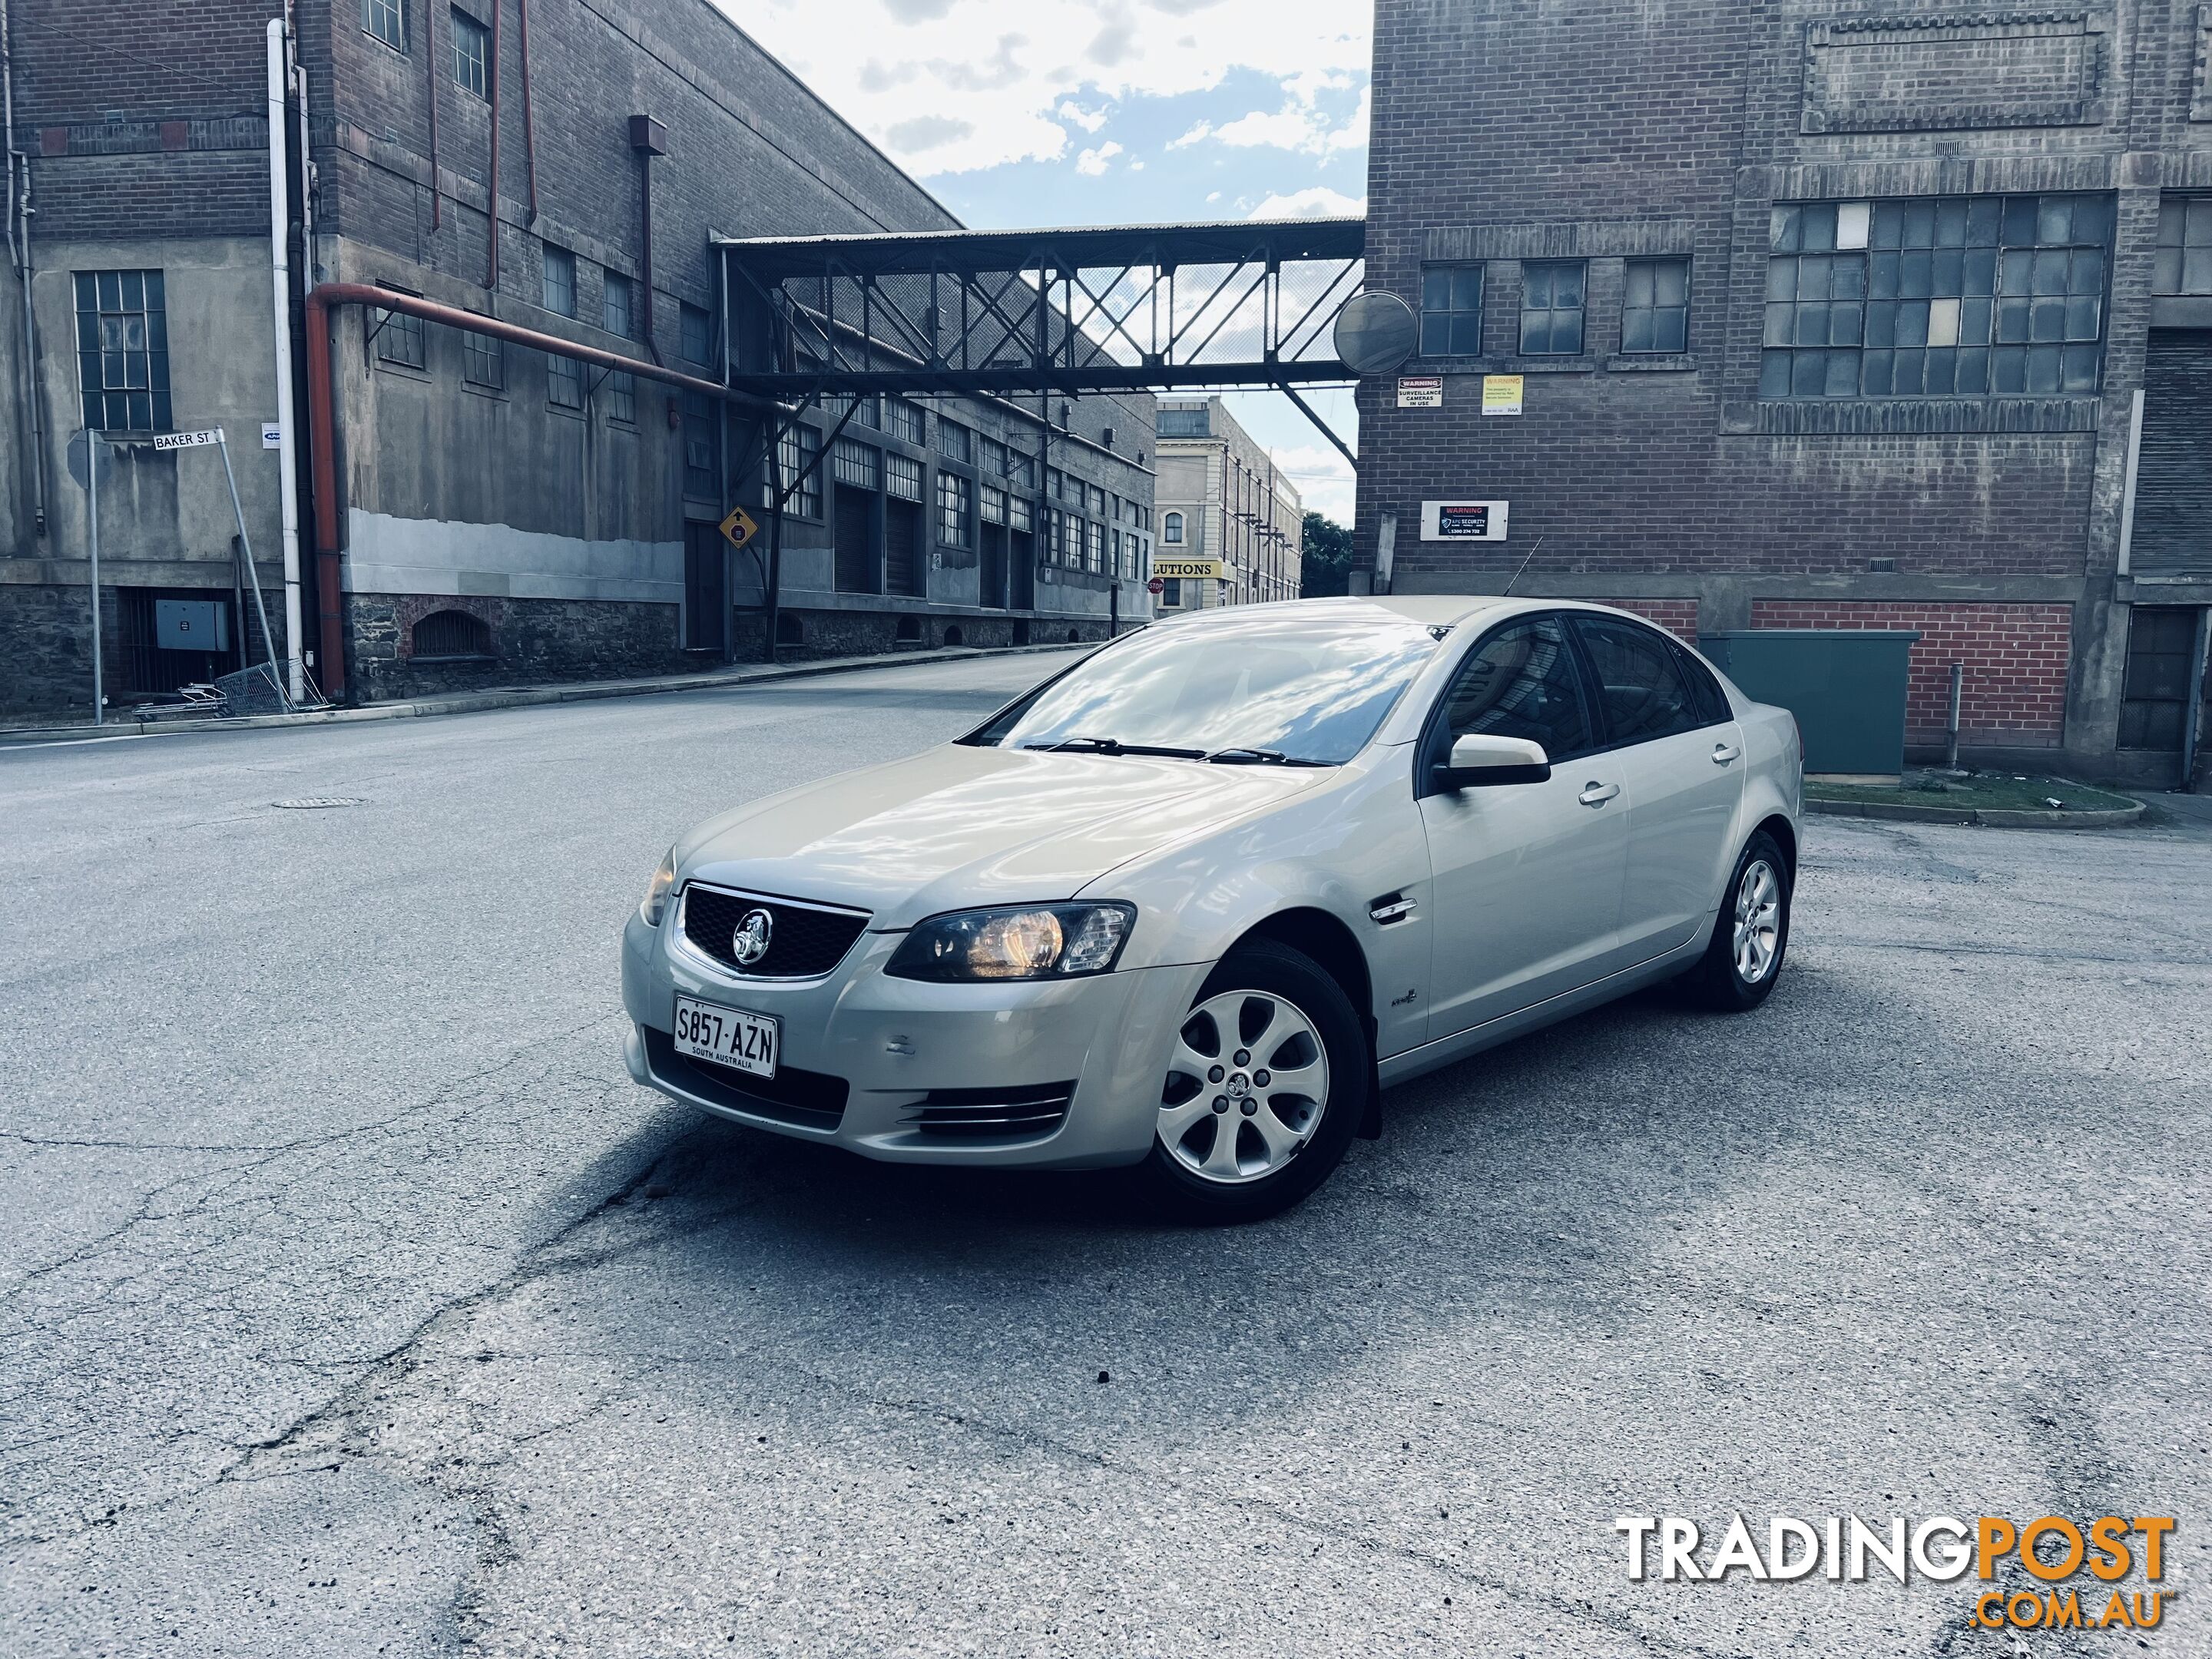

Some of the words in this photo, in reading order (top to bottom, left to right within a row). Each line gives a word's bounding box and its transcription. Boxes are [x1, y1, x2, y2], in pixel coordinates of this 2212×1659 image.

[156, 434, 193, 448] BAKER
[197, 432, 210, 443] ST
[692, 1046, 714, 1058] SOUTH
[715, 1053, 752, 1069] AUSTRALIA
